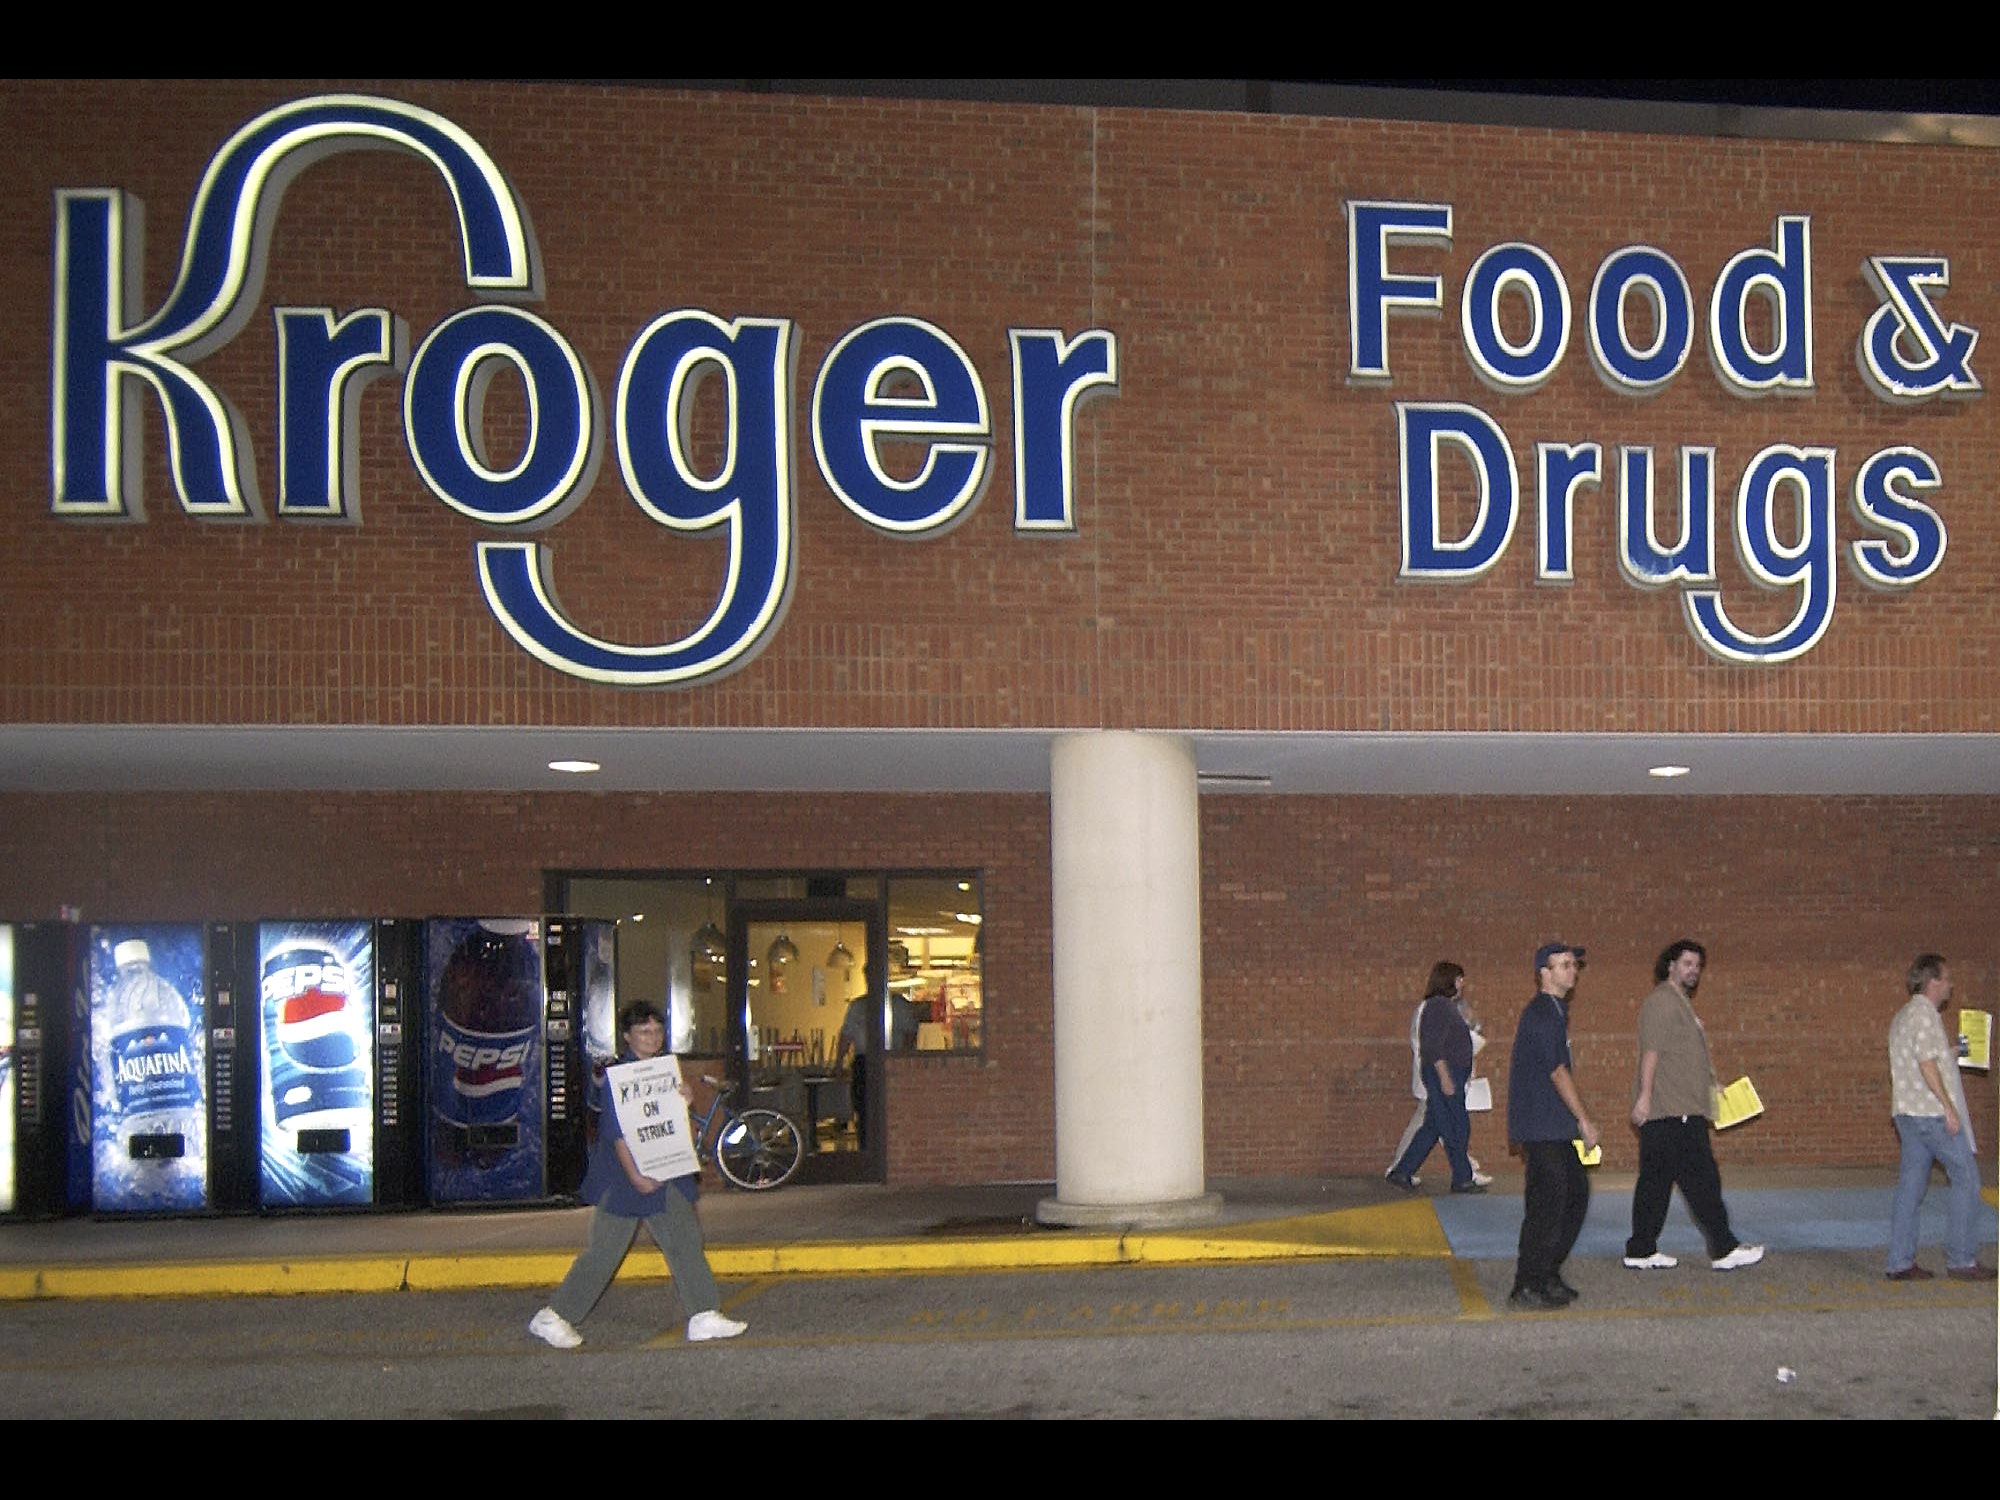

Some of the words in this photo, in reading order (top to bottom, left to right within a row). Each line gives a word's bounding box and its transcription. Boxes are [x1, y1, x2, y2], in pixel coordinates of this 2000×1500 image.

[1346, 200, 1815, 390] Food
[1860, 256, 1982, 397] &
[49, 94, 1118, 686] Kroger
[1395, 401, 1948, 661] Drugs
[261, 964, 350, 1002] PEPS
[117, 1044, 191, 1083] AQUAFINA
[439, 1030, 531, 1071] PEPSI
[643, 1100, 659, 1117] ON
[637, 1120, 674, 1143] STRIKE
